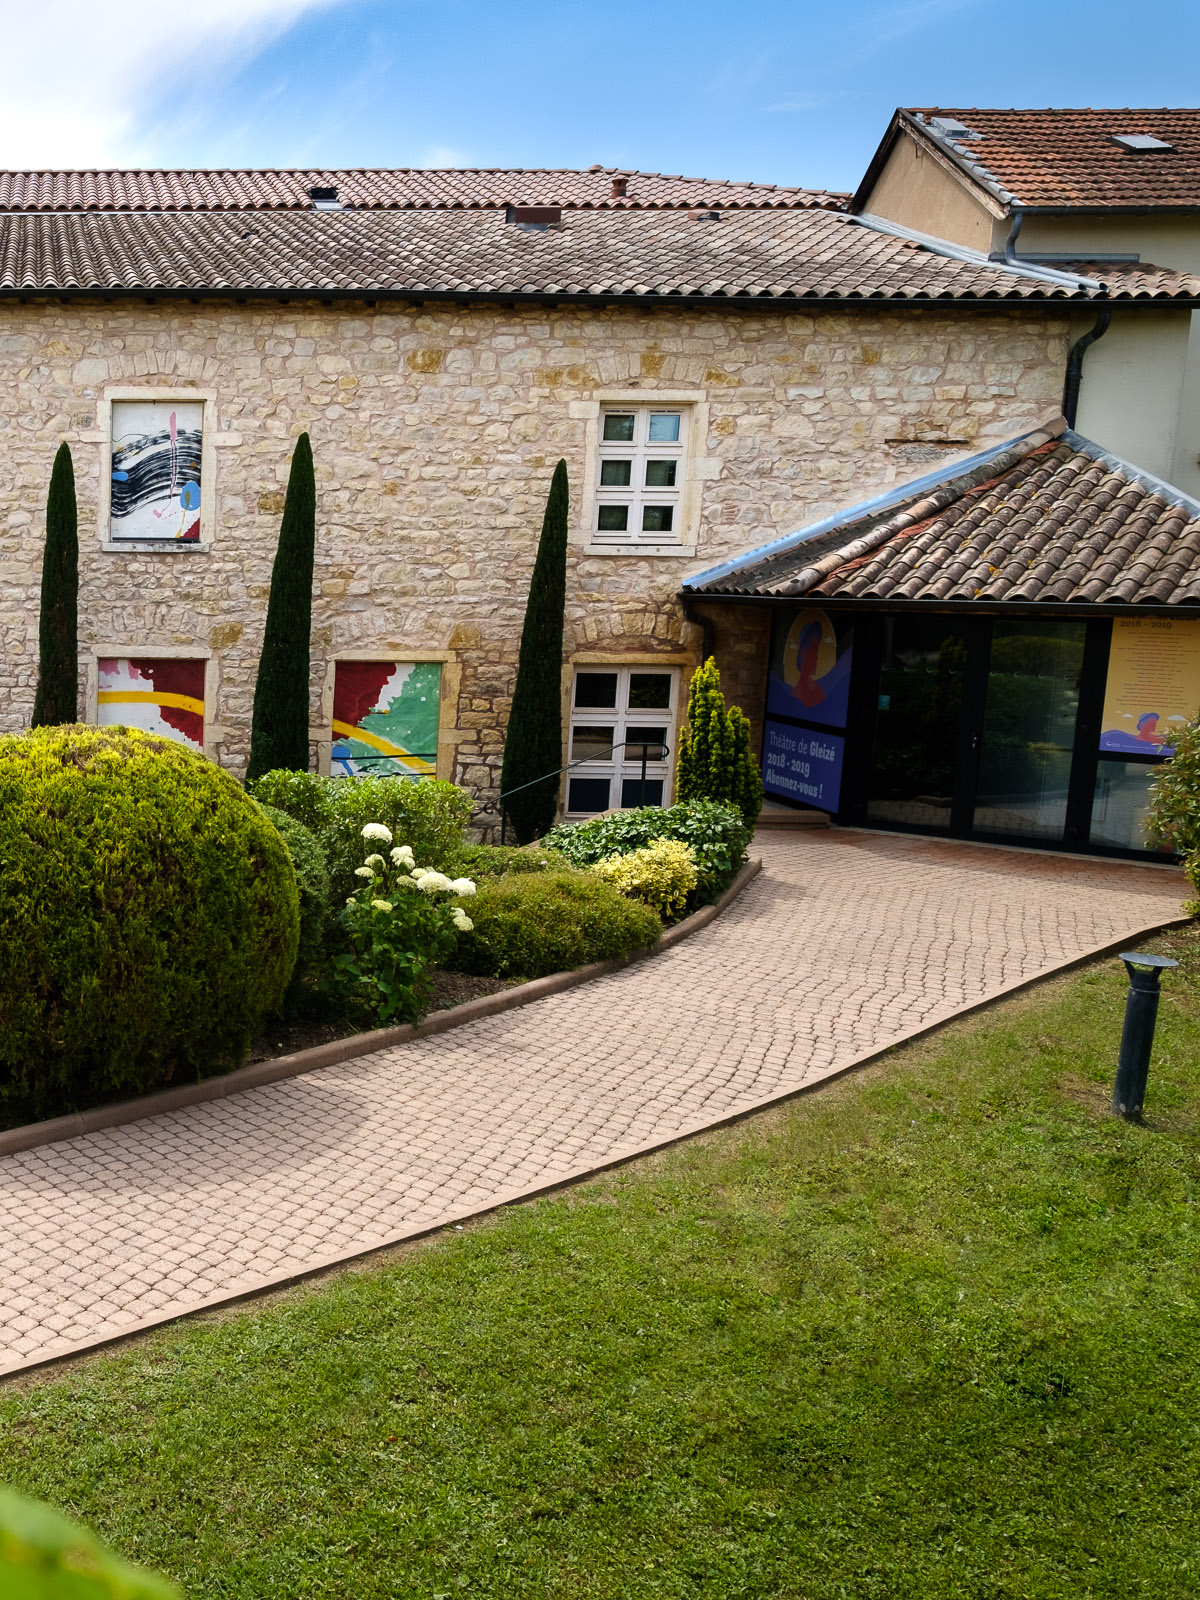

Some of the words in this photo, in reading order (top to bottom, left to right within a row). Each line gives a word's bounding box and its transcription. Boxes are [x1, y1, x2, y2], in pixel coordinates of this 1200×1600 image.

[1120, 620, 1141, 628] 2018
[1151, 621, 1172, 630] 2019
[770, 732, 796, 751] Théâtre
[798, 738, 808, 754] de
[810, 741, 835, 762] Gleizé
[767, 752, 785, 768] 2018
[791, 759, 810, 778] 2019
[766, 769, 818, 797] Abonnez-vous
